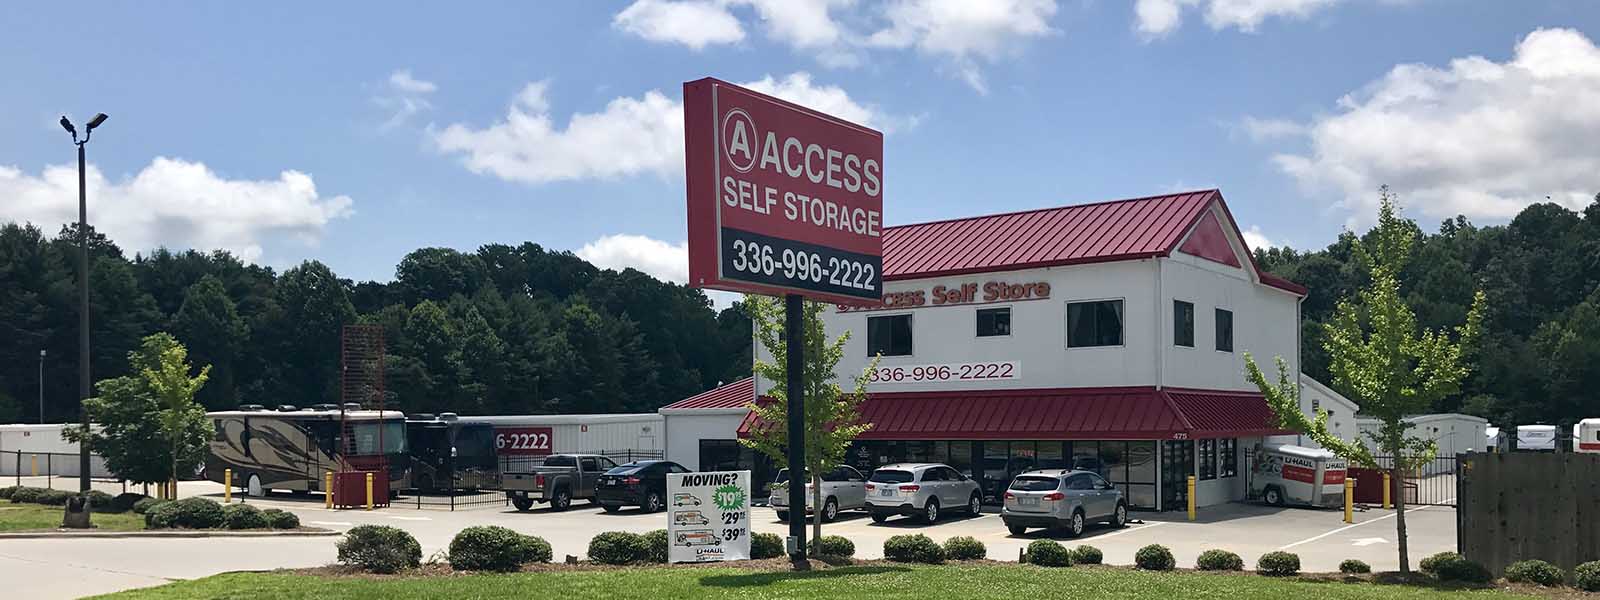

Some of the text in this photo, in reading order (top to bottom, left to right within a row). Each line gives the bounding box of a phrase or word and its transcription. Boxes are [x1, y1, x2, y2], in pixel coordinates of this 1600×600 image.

[760, 131, 880, 197] ACCESS
[723, 176, 880, 237] SELF STORAGE
[733, 239, 875, 291] 336-996-2222
[932, 283, 977, 305] Self
[983, 281, 1050, 301] Store
[681, 473, 738, 487] MOVING?
